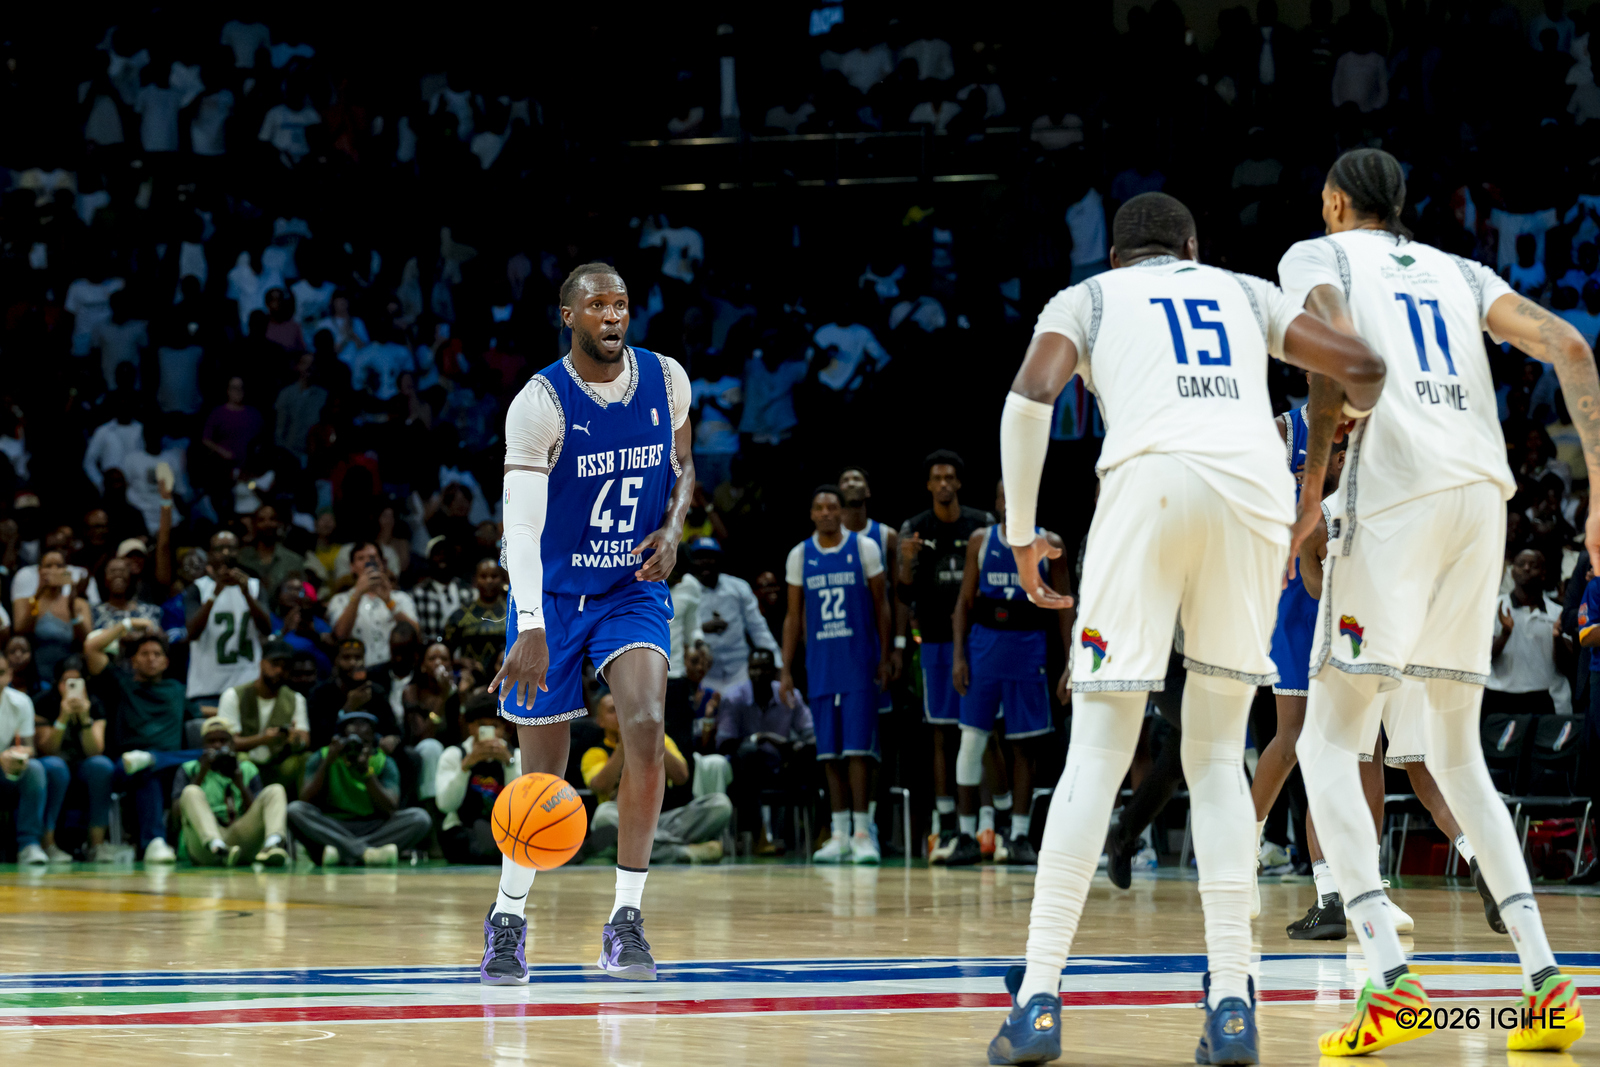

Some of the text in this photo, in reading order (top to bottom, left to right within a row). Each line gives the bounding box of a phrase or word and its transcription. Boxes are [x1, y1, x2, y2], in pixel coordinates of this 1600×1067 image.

[1148, 297, 1231, 367] 15
[1394, 292, 1458, 377] 11
[1177, 375, 1240, 400] GAKOU
[577, 443, 664, 478] RSSB TIGERS
[589, 476, 644, 534] 45
[571, 553, 643, 569] RWANDA
[589, 538, 634, 554] VISIT
[818, 586, 847, 621] 22
[1003, 586, 1016, 601] 7
[214, 610, 254, 665] 24
